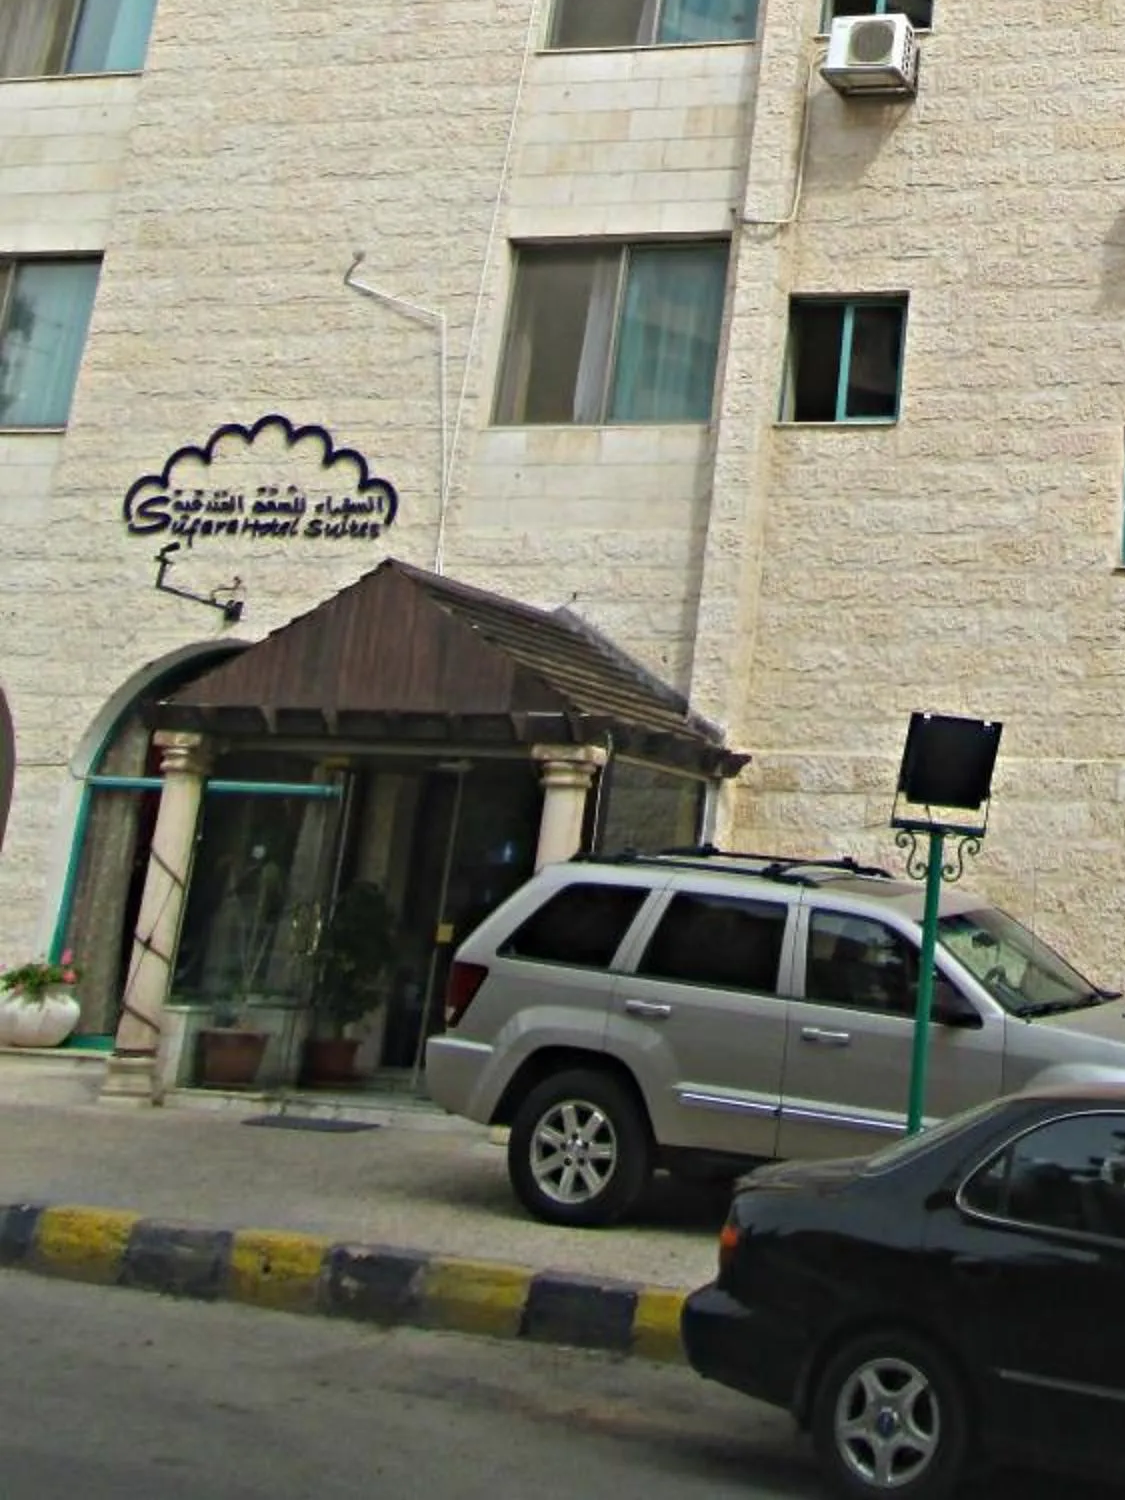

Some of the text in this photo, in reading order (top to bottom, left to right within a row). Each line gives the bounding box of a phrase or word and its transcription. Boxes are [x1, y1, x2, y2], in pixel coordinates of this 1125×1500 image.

[127, 495, 382, 548] Sufara Hotel Suites
